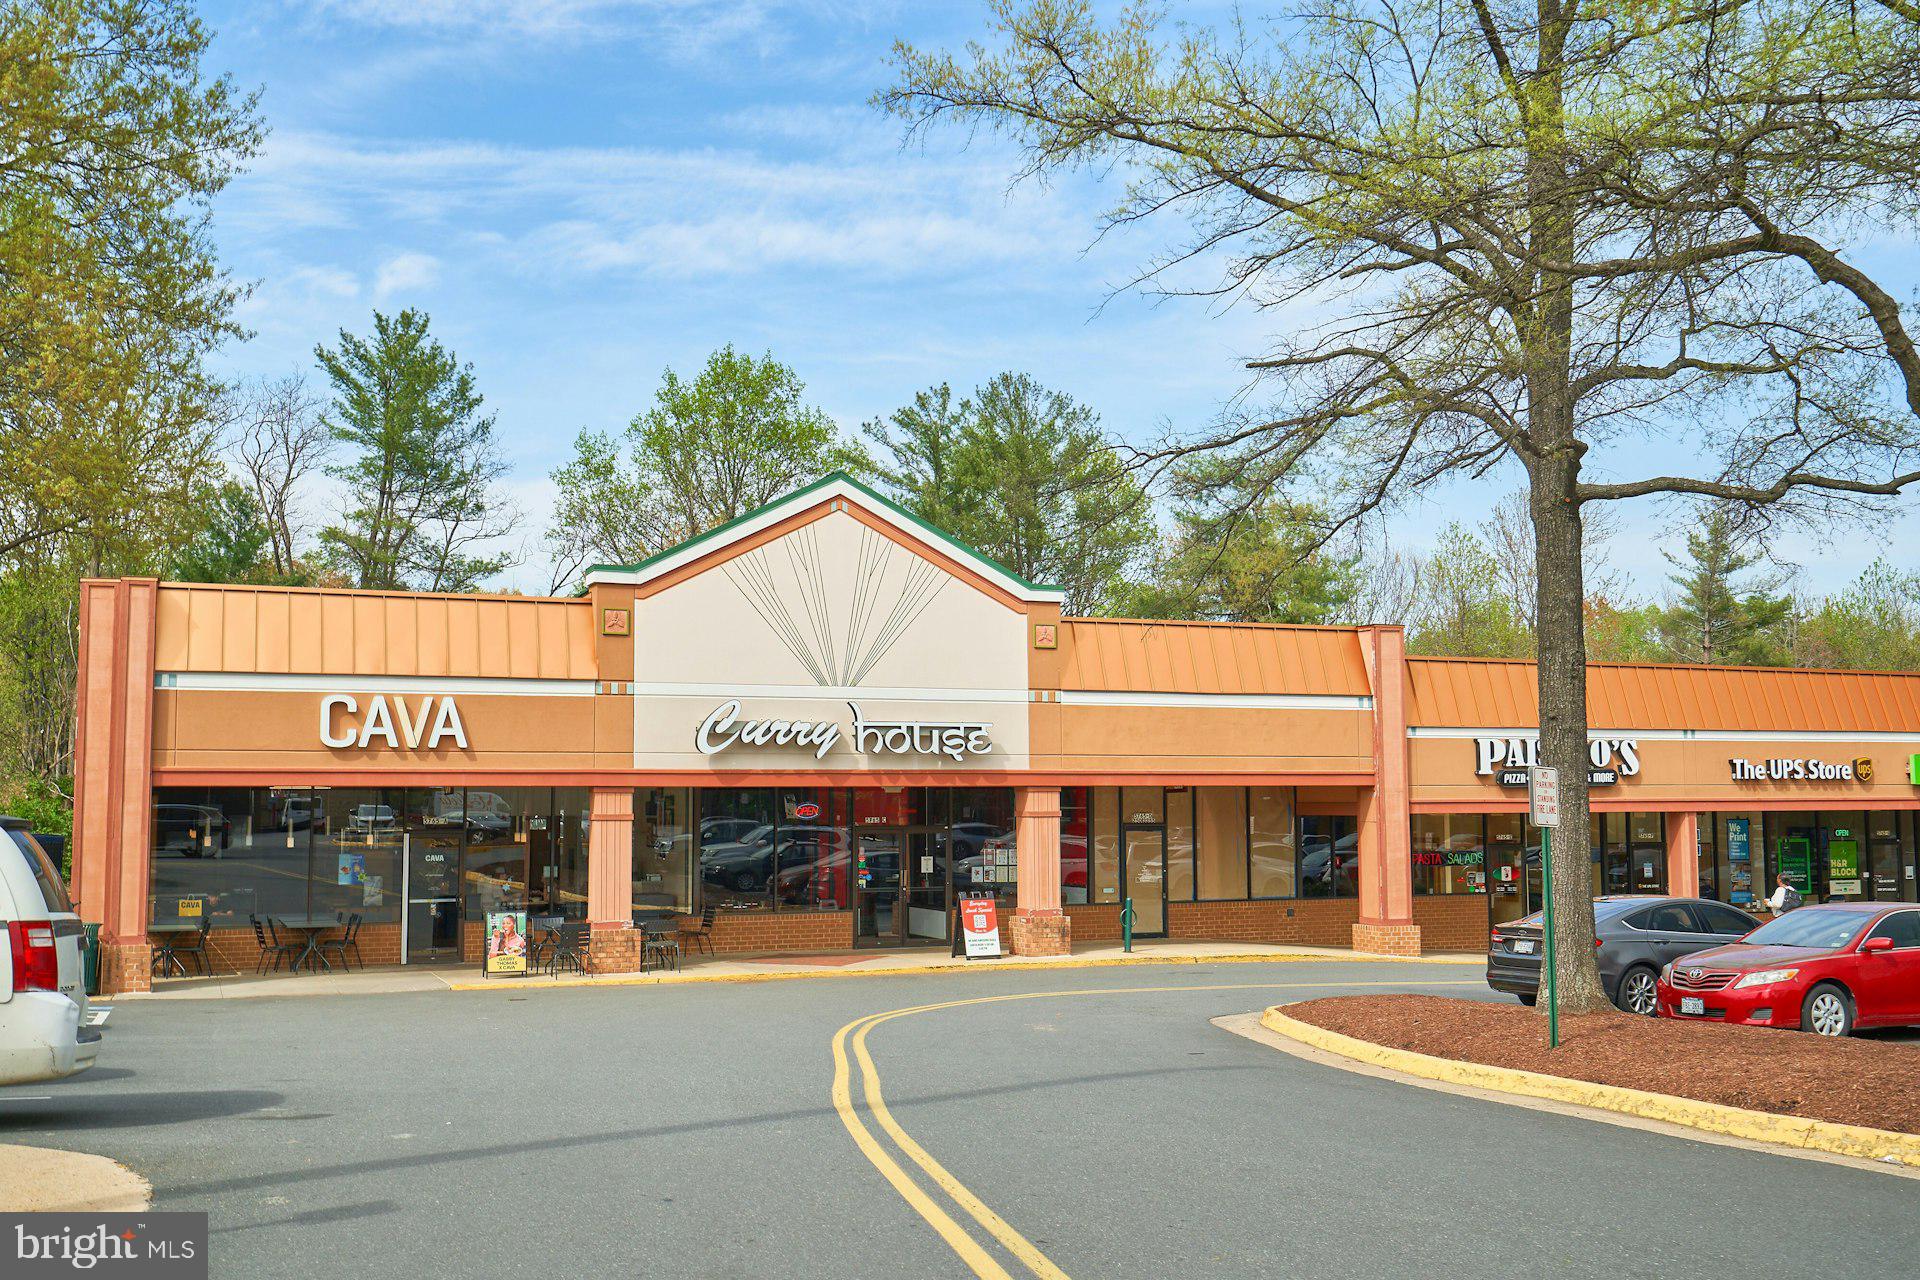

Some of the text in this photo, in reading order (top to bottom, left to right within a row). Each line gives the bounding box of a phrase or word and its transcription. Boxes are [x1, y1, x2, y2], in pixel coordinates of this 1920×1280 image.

[320, 694, 467, 748] CAVA
[696, 699, 993, 761] Curry house
[1476, 738, 1640, 776] PAIO'S
[1541, 771, 1549, 779] NO
[1732, 759, 1851, 780] The UPS Store
[1858, 765, 1872, 777] ups
[1504, 773, 1526, 784] PIZZA
[1594, 772, 1615, 783] MORE
[1536, 780, 1556, 789] PARKING
[1537, 795, 1556, 804] STANDING
[796, 805, 818, 816] OPEN
[1536, 803, 1557, 815] FIRE LANE
[1728, 823, 1741, 832] We
[1729, 832, 1747, 842] Print
[425, 854, 445, 862] CAVA
[1412, 852, 1484, 865] PASTA SALADS
[1830, 859, 1848, 867] H&R
[1830, 868, 1857, 876] BLOCK
